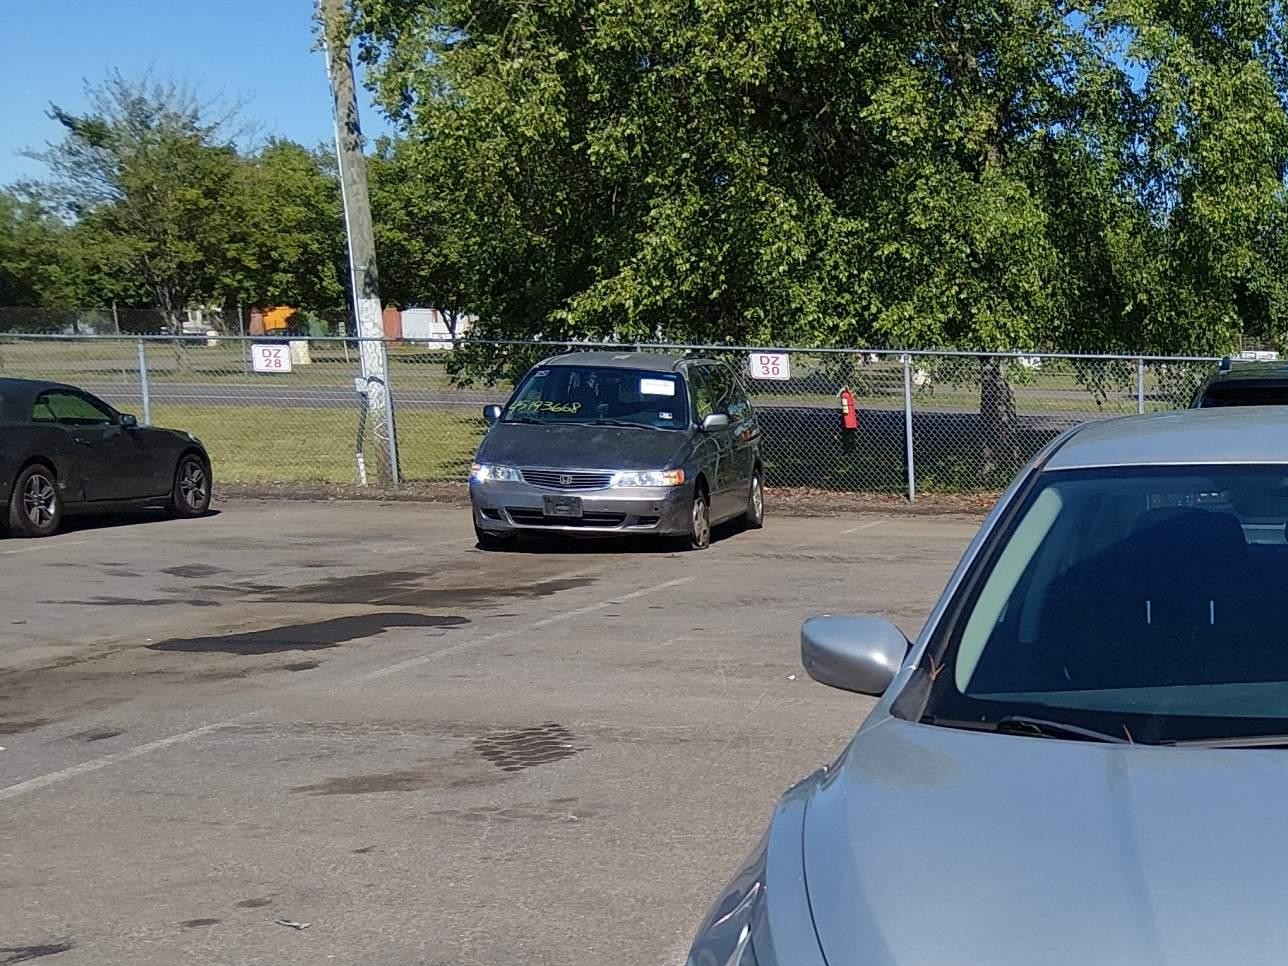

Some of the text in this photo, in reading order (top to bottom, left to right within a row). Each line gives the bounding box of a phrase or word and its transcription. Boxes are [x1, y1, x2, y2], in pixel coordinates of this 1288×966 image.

[262, 349, 281, 358] DZ
[264, 359, 282, 368] 28
[760, 355, 780, 366] DZ
[761, 366, 780, 376] 30
